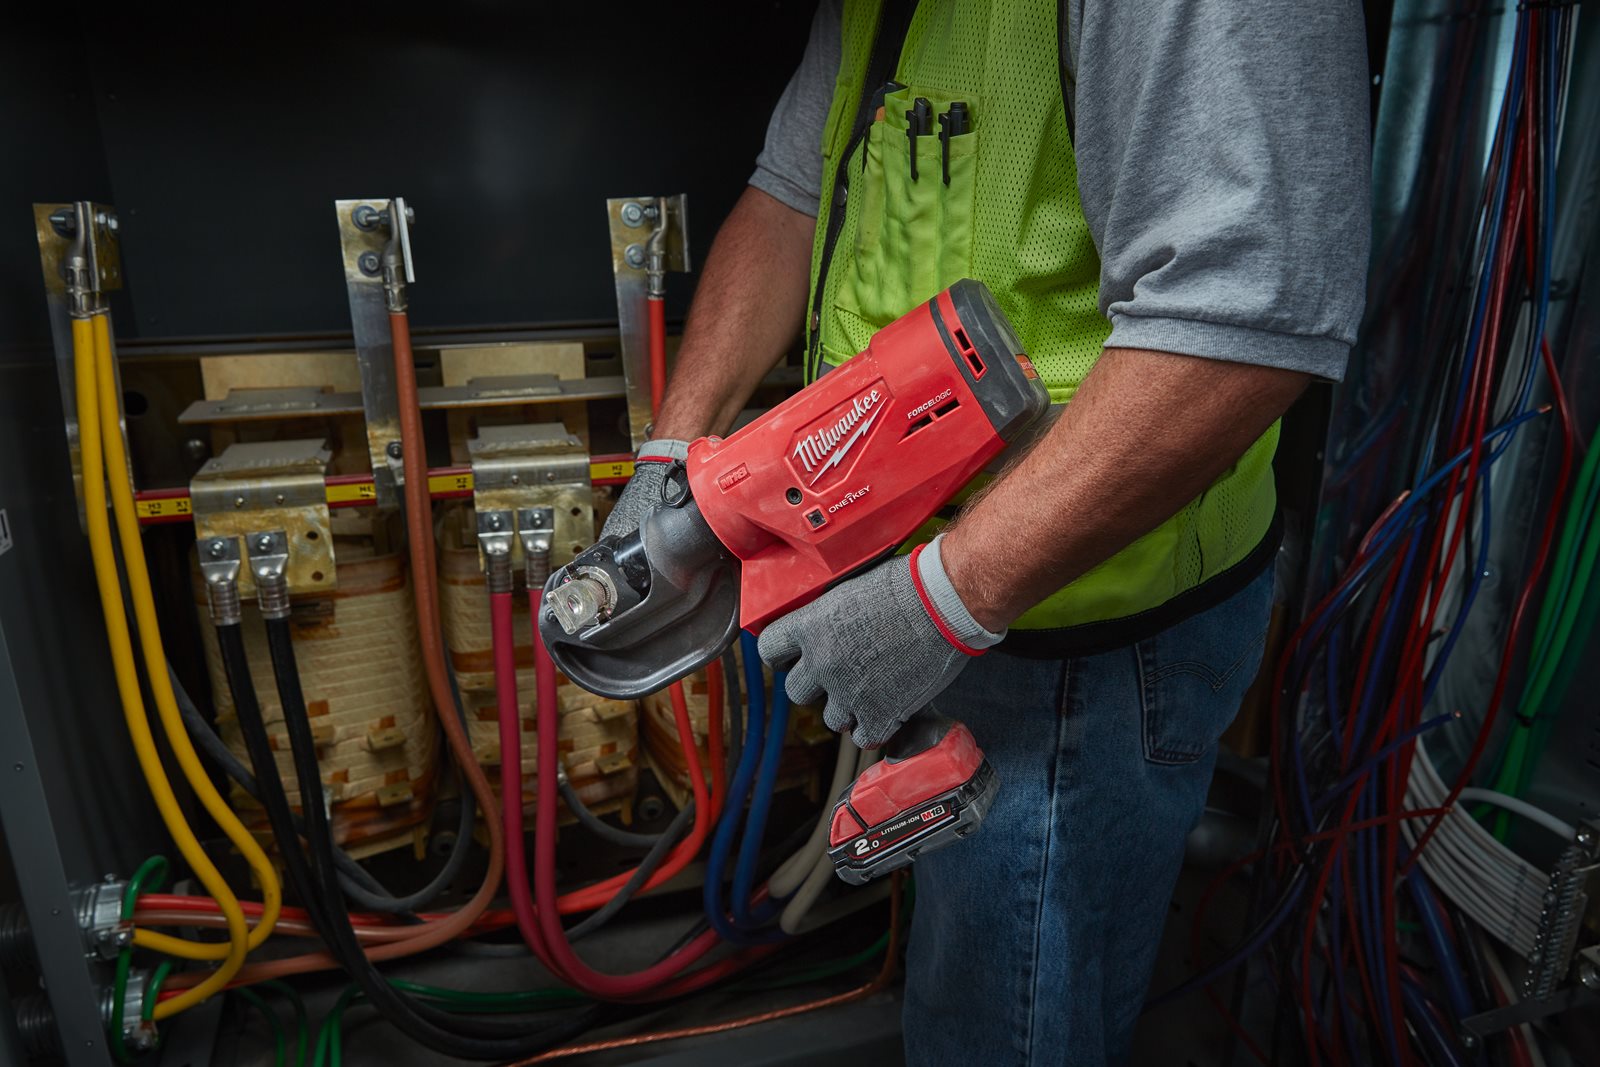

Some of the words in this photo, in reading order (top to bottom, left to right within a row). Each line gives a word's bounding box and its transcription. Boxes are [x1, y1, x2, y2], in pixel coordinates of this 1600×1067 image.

[907, 388, 953, 419] FORCELOGIC
[792, 389, 882, 473] Milwaukee
[720, 466, 748, 489] M18
[921, 806, 944, 821] M18
